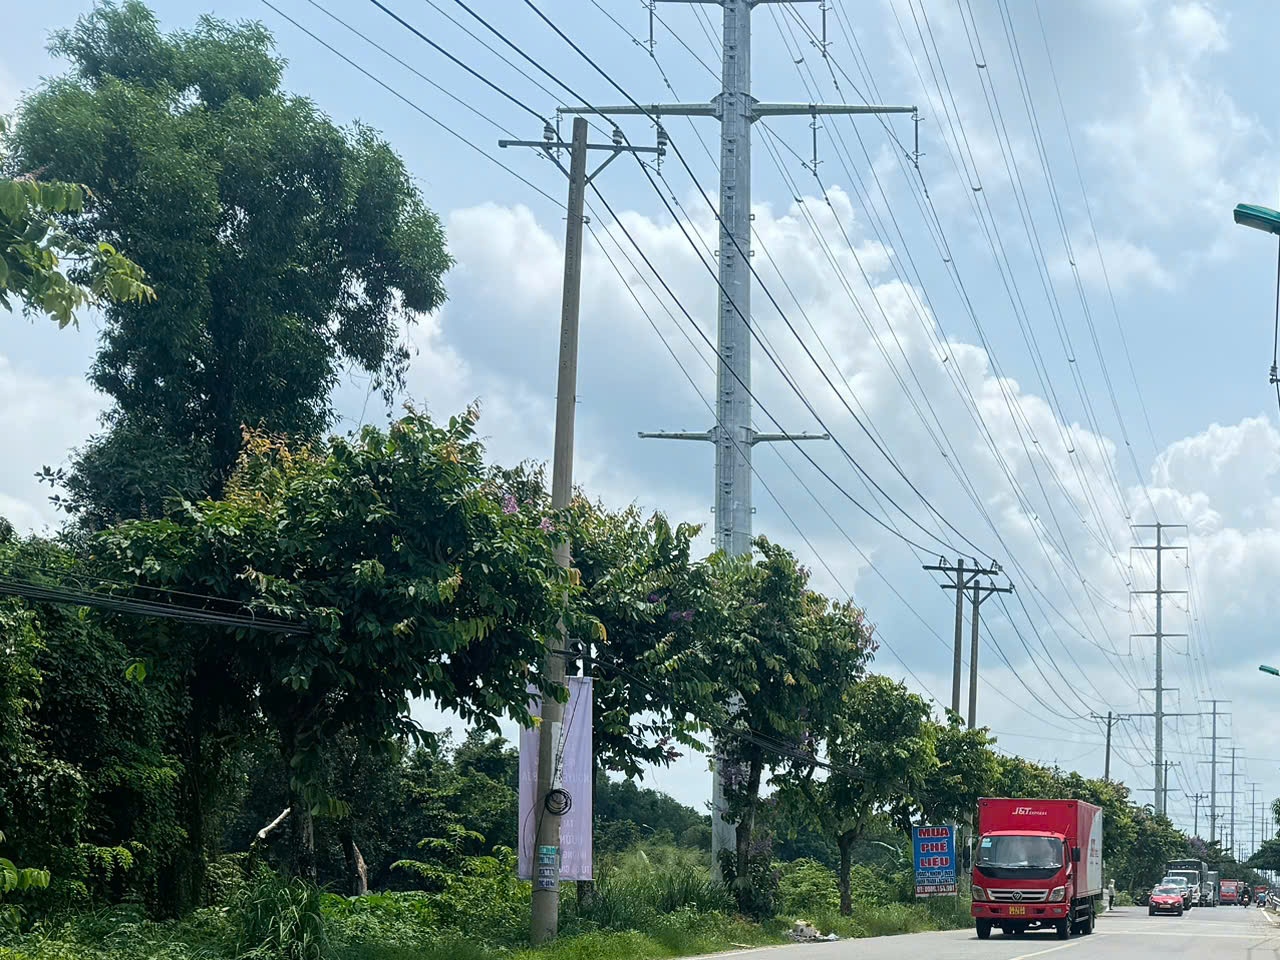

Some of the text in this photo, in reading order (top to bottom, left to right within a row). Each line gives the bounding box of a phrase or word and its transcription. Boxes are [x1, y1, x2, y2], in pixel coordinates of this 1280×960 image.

[918, 827, 950, 838] MUA
[921, 839, 948, 853] PHẾ
[920, 855, 950, 868] LIỆU
